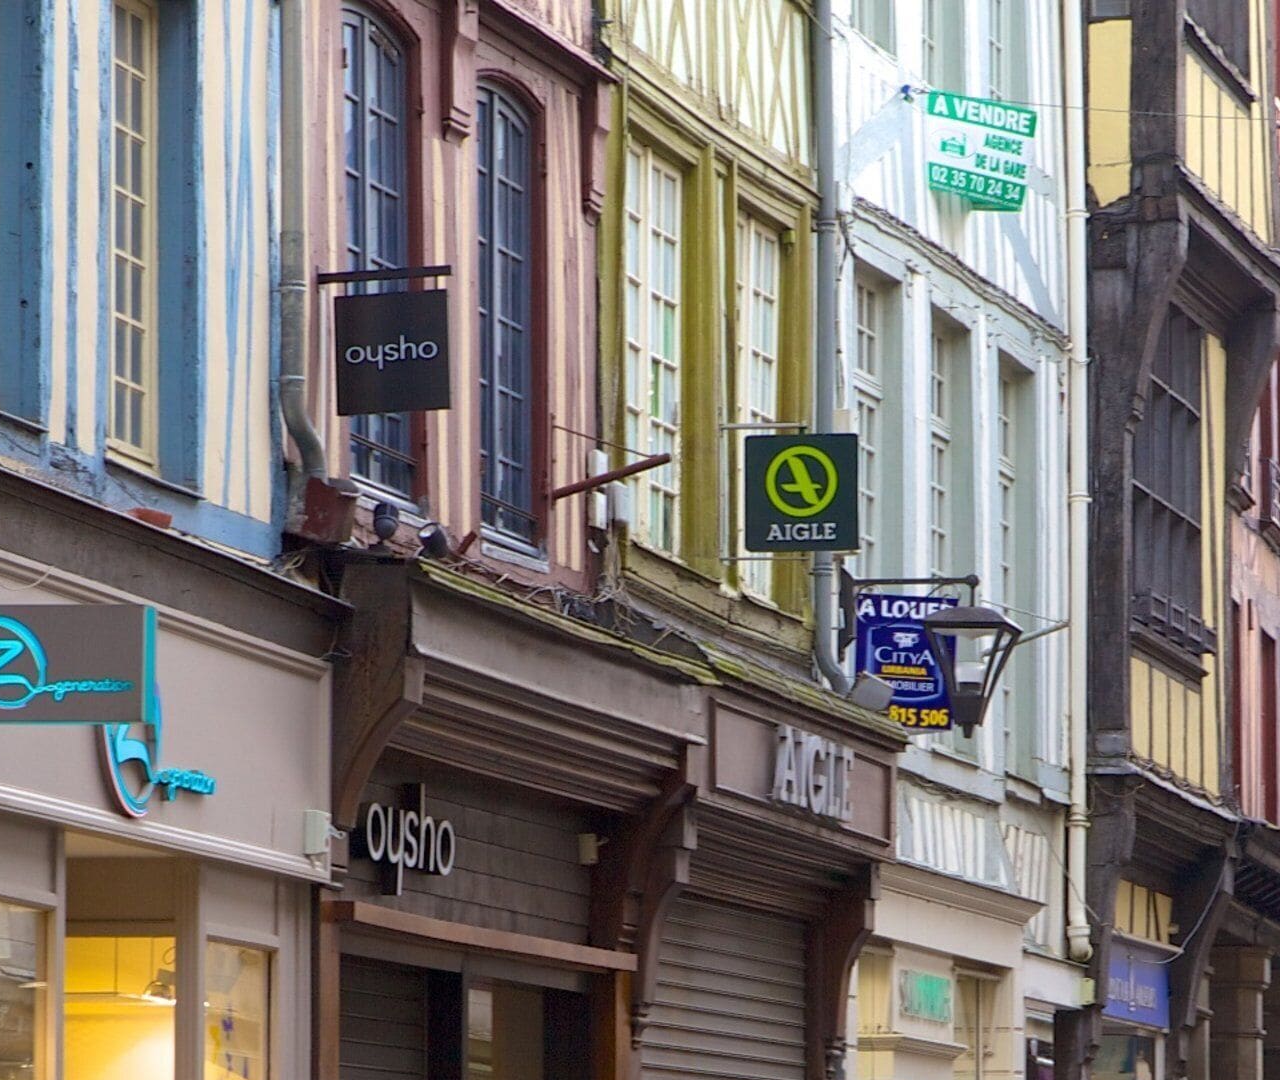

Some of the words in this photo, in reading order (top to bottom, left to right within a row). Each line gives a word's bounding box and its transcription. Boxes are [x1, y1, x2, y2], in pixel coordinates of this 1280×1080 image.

[933, 94, 950, 116] A
[952, 97, 1032, 134] VENDRE
[931, 165, 949, 184] 02
[950, 169, 967, 188] 35
[987, 179, 1003, 197] 24
[1004, 183, 1021, 201] 34
[345, 334, 438, 370] oysho
[766, 522, 837, 541] AIGLE
[860, 598, 876, 617] A
[880, 600, 954, 620] LOUE
[888, 705, 917, 725] 815
[919, 708, 949, 727] 506
[772, 724, 855, 821] AIGLE
[366, 783, 456, 896] oysho
